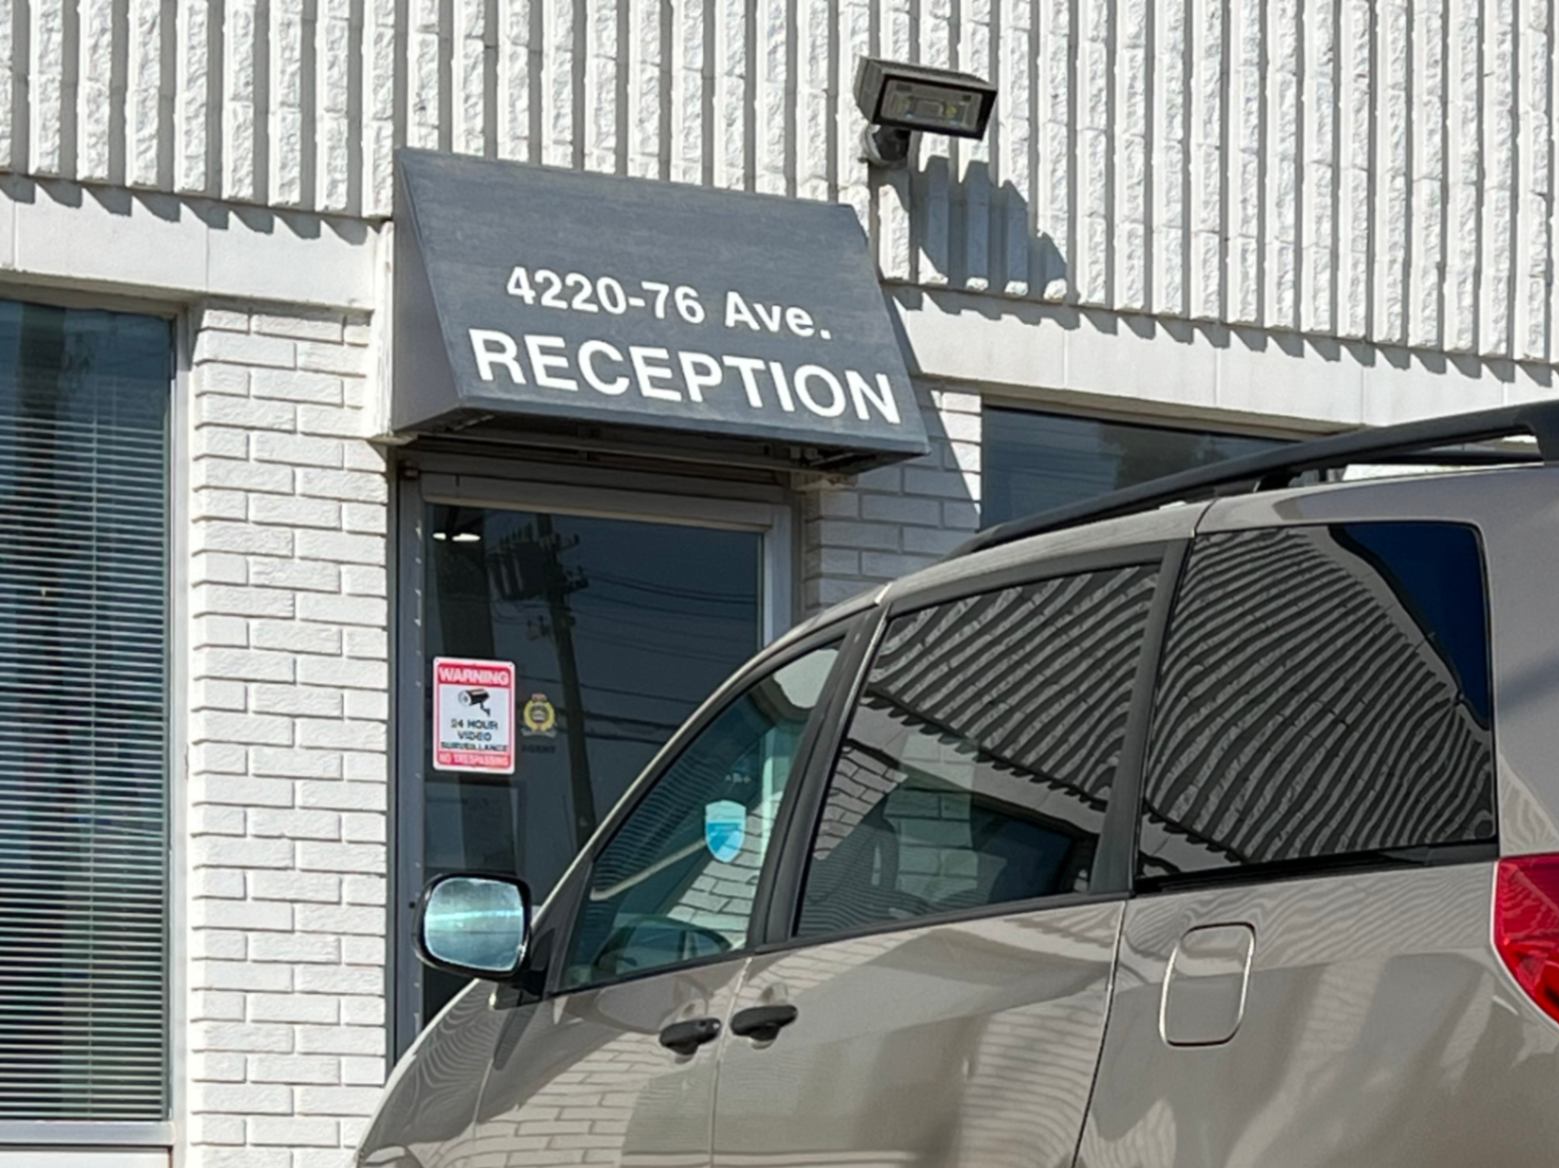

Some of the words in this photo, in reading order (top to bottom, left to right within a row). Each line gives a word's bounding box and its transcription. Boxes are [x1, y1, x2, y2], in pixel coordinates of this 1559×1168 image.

[506, 266, 704, 324] 4220-76
[724, 291, 832, 340] Ave.
[468, 328, 900, 424] RECEPTION
[440, 667, 509, 686] WARNING
[467, 719, 498, 730] HOUR
[457, 731, 492, 741] VIDEO
